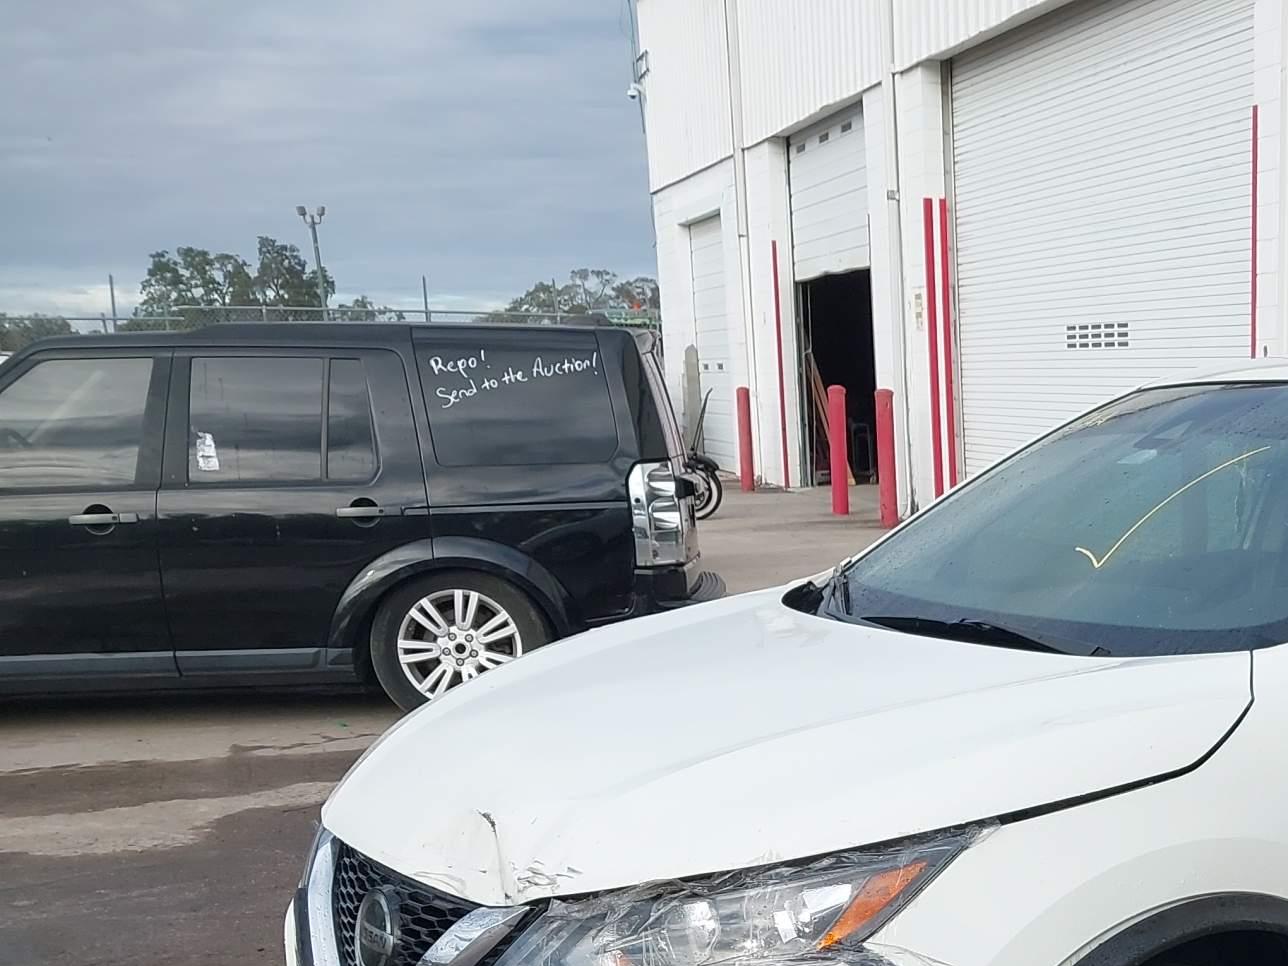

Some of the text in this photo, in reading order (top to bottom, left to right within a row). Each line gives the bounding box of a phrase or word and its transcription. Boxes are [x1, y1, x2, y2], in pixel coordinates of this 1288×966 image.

[429, 349, 491, 378] Repo!
[436, 379, 478, 408] Send
[481, 379, 498, 391] to
[532, 351, 598, 377] Auction!
